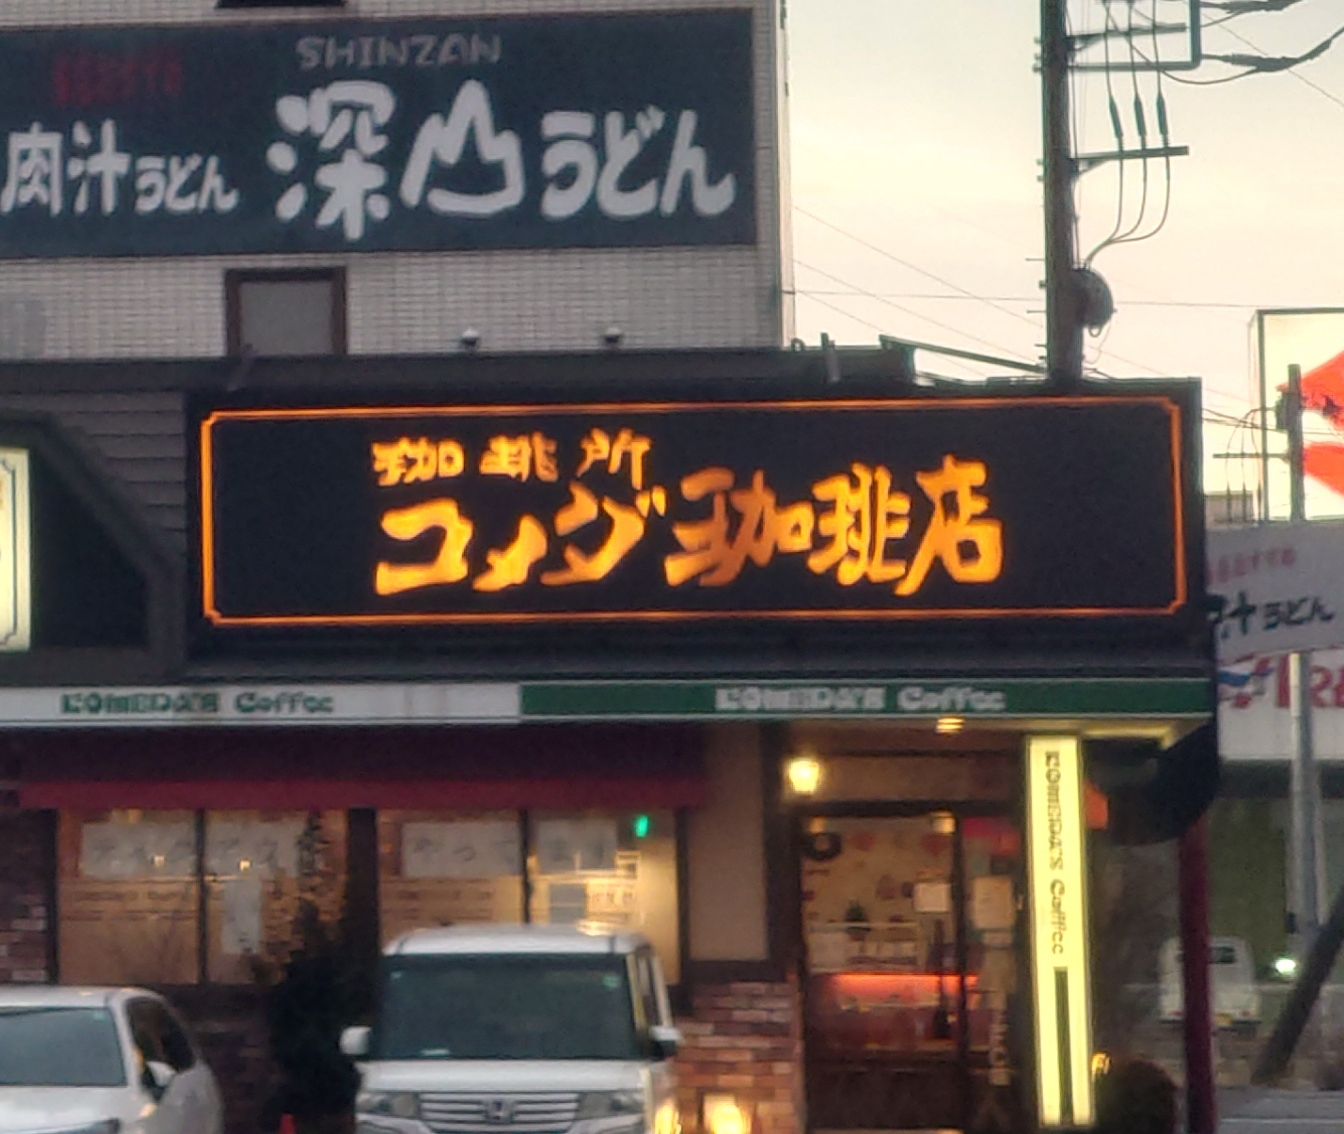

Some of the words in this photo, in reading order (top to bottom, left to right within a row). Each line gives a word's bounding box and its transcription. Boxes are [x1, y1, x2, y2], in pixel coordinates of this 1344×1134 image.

[297, 33, 500, 68] SHINZAN
[0, 120, 238, 215] 肉汁うどん
[267, 79, 734, 241] 深山うどん
[374, 454, 1005, 597] コメダ珈琲店
